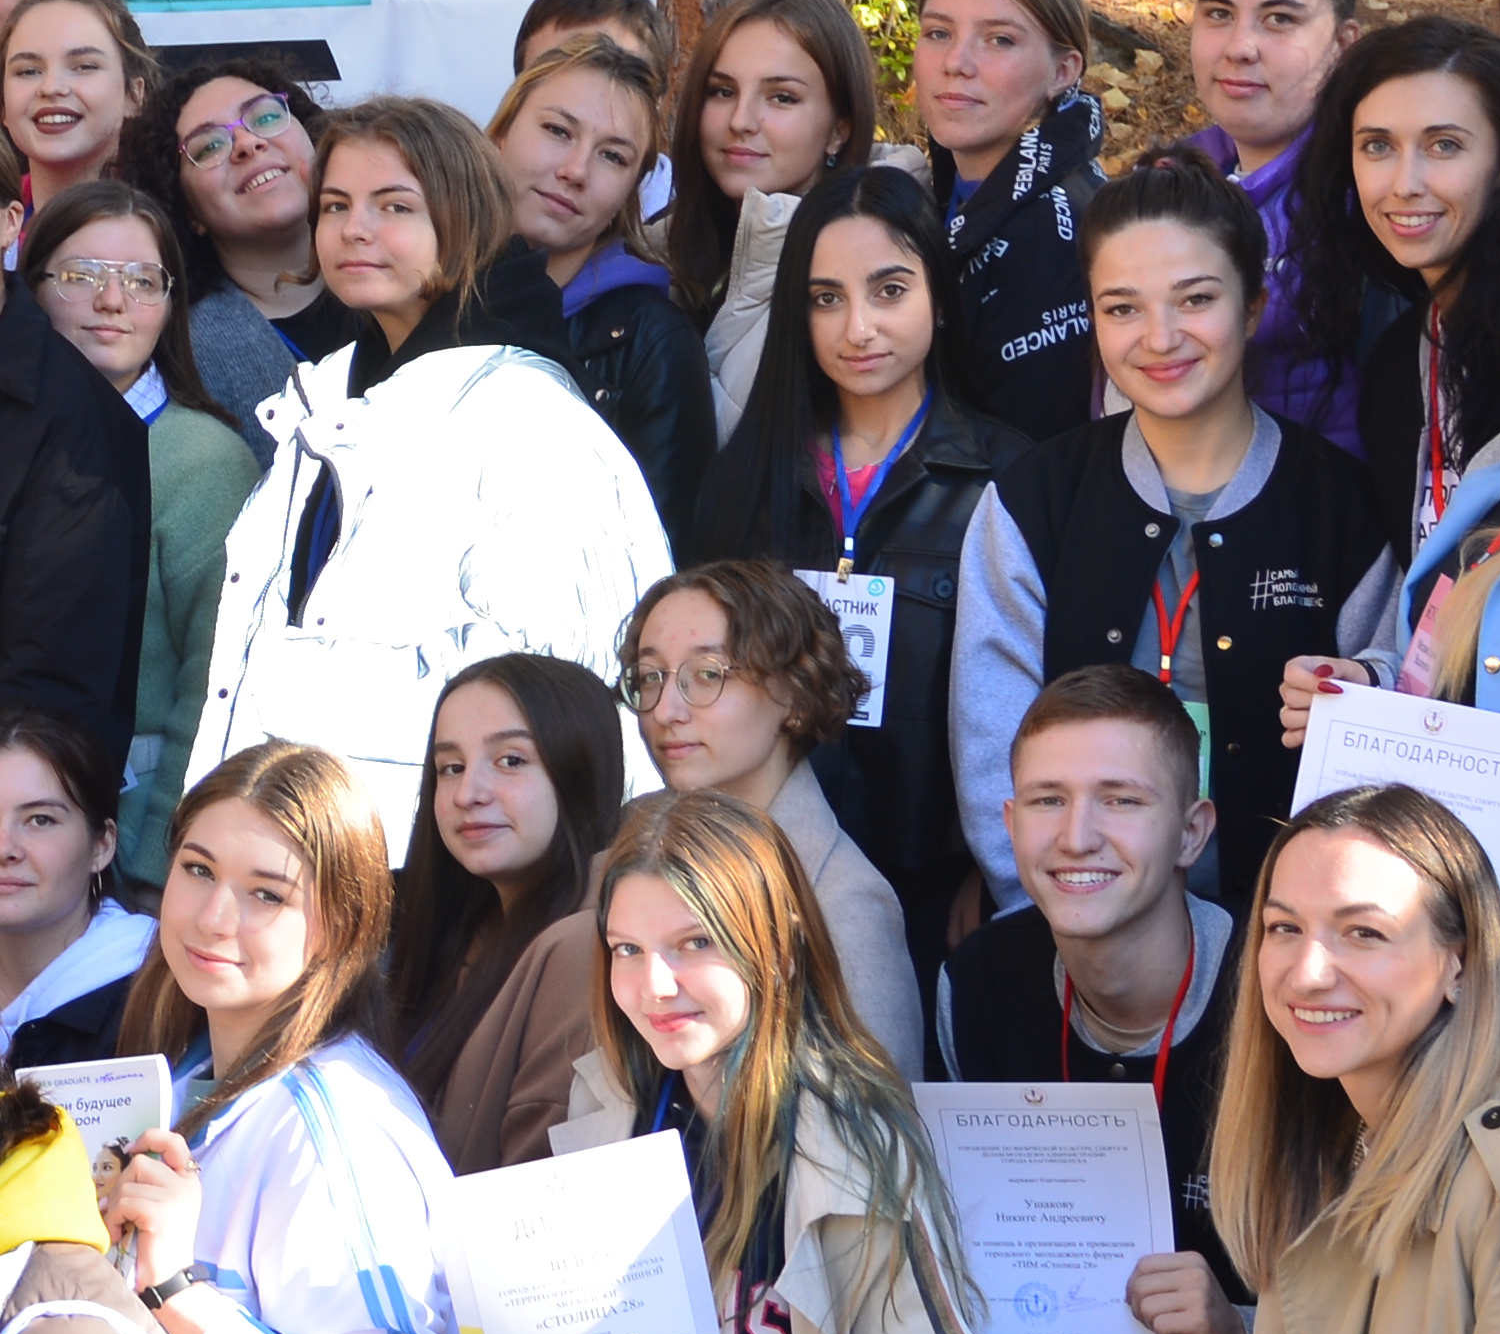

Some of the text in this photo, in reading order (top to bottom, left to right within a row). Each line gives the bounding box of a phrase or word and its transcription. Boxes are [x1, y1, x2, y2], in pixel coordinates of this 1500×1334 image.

[1042, 299, 1087, 325] PARIS
[824, 598, 879, 616] АСТНИК
[53, 1076, 91, 1087] GRADUATE
[76, 1095, 132, 1111] будущее
[74, 1116, 101, 1126] ром
[955, 1114, 1127, 1129] БЛАГОДАРНОСТЬ
[1023, 1198, 1075, 1211] Ушакову
[996, 1212, 1107, 1225] Никите Андреевичу
[536, 1298, 645, 1331] «СТОЛИЦА 28»
